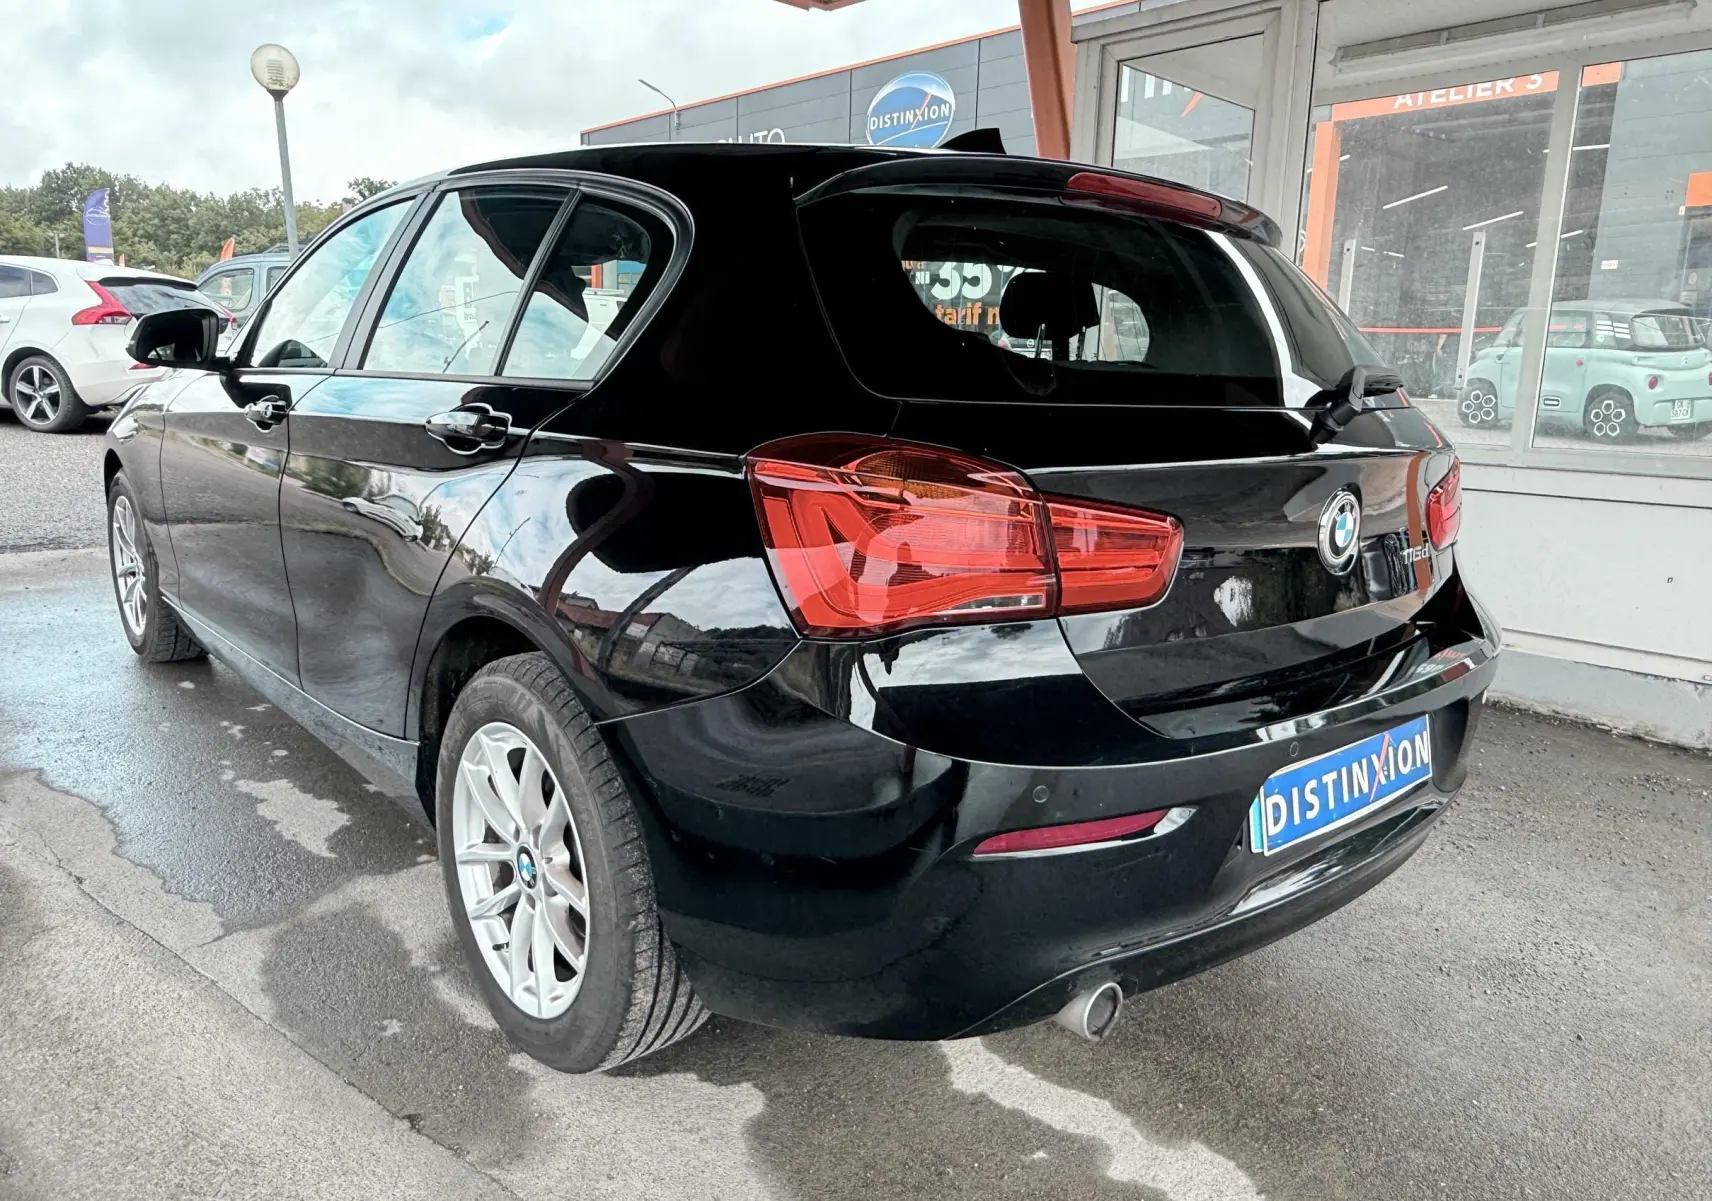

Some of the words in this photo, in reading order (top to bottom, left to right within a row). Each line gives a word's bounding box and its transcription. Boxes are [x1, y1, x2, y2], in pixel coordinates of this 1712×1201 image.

[1393, 78, 1516, 109] ATELIER
[870, 102, 950, 131] DISTINXION
[935, 302, 983, 325] tarif
[1266, 730, 1429, 837] DISTINXION
